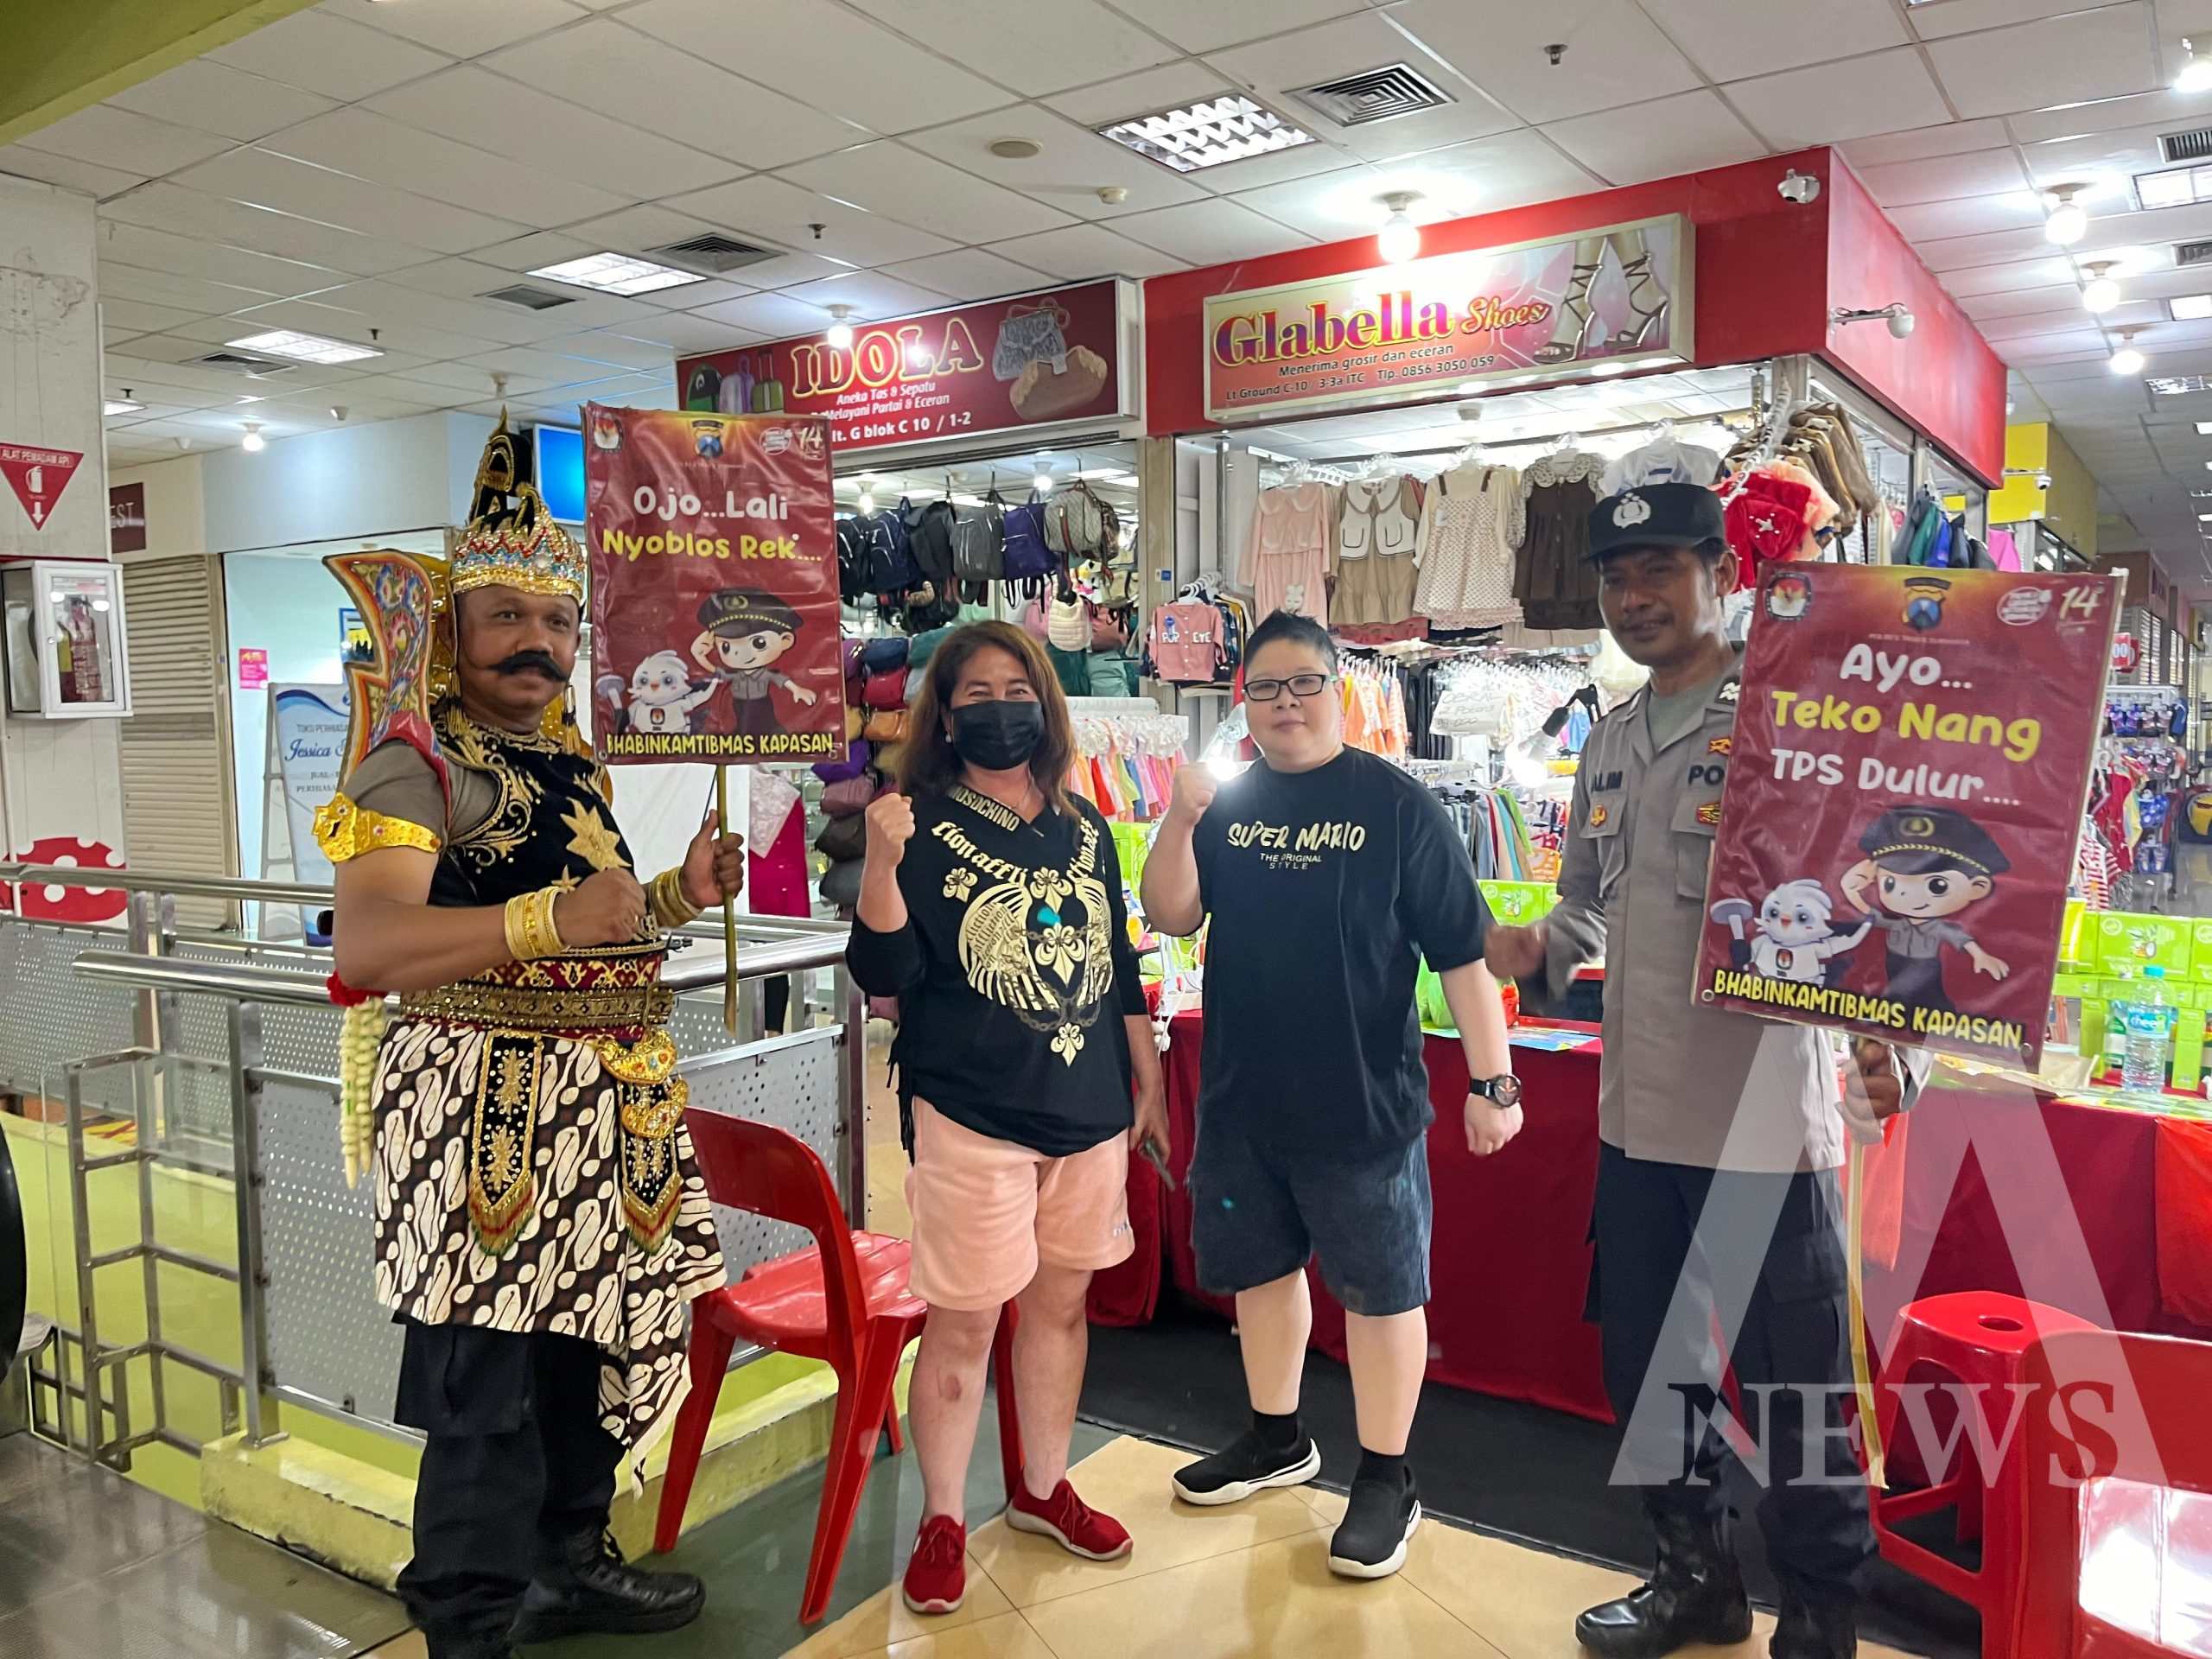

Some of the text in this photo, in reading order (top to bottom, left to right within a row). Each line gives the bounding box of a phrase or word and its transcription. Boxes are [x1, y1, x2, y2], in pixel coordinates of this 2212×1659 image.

[1213, 289, 1554, 367] Glabella Shoes
[791, 317, 984, 398] IDOLA
[1279, 345, 1454, 377] Menerima grosir dan eceran
[1239, 385, 1281, 398] Ground
[1346, 372, 1365, 385] ITC
[1402, 365, 1432, 377] 0856
[1436, 359, 1467, 373] 3050
[1471, 355, 1494, 368] 059
[836, 393, 868, 405] Aneka
[871, 388, 888, 401] Tas
[900, 381, 936, 397] Sepatu
[872, 400, 903, 415] Partai
[914, 394, 950, 409] Eceran
[850, 427, 861, 439] G
[864, 422, 895, 438] blok
[898, 421, 907, 433] C
[913, 417, 931, 431] 10
[937, 415, 944, 432] /
[950, 412, 971, 427] 1-2
[603, 529, 730, 562] Nyoblos
[2059, 585, 2100, 620] 14
[1771, 690, 2042, 762] Teko Nang
[284, 738, 332, 761] Jessica
[607, 733, 834, 754] BHABINKAMTIBMAS KAPASAN
[1770, 747, 1845, 785] TPS
[1227, 821, 1365, 852] SUPER MARIO
[1259, 853, 1322, 862] THE ORIGINAL
[1713, 969, 2023, 1051] BHABINKAMTIBMAS KAPASAN
